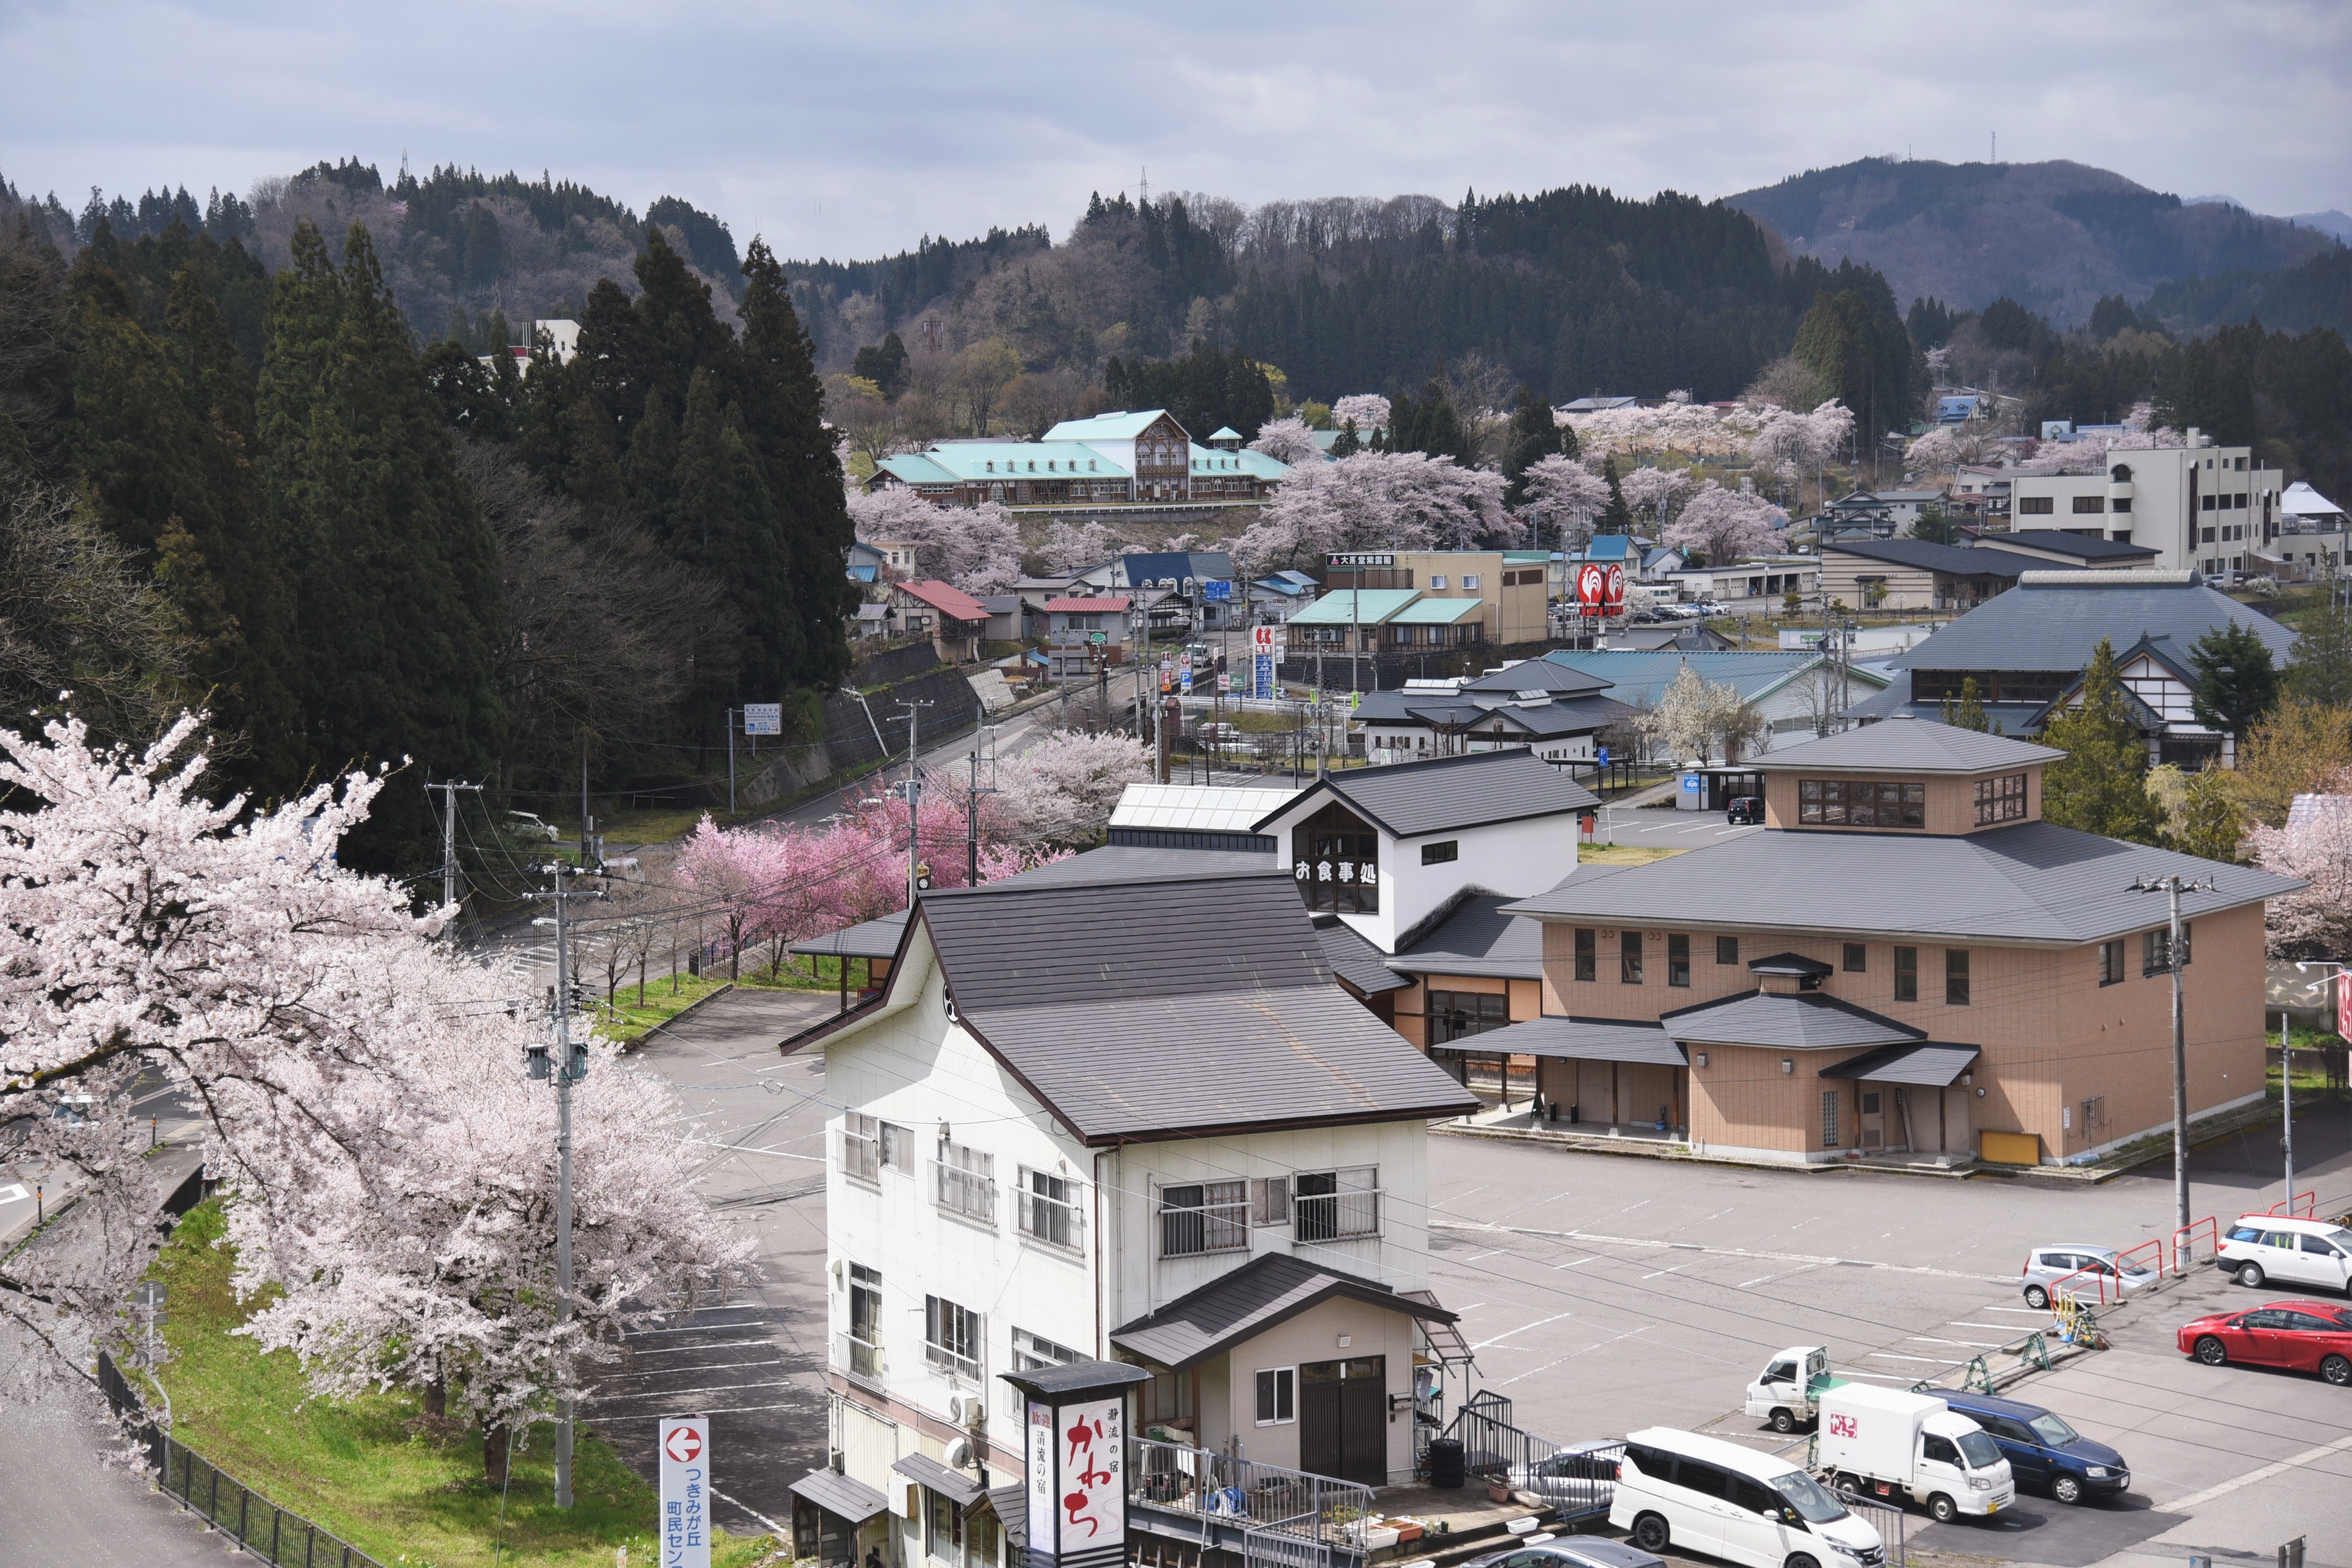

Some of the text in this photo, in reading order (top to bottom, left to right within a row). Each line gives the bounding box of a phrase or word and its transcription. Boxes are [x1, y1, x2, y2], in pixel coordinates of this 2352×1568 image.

[1296, 861, 1376, 884] お食事処
[1032, 1411, 1050, 1428] 歓迎
[1037, 1430, 1046, 1495] 清流の宿
[1064, 1414, 1111, 1537] かわち
[667, 1501, 683, 1568] 町民セン
[686, 1468, 702, 1546] つきみが丘
